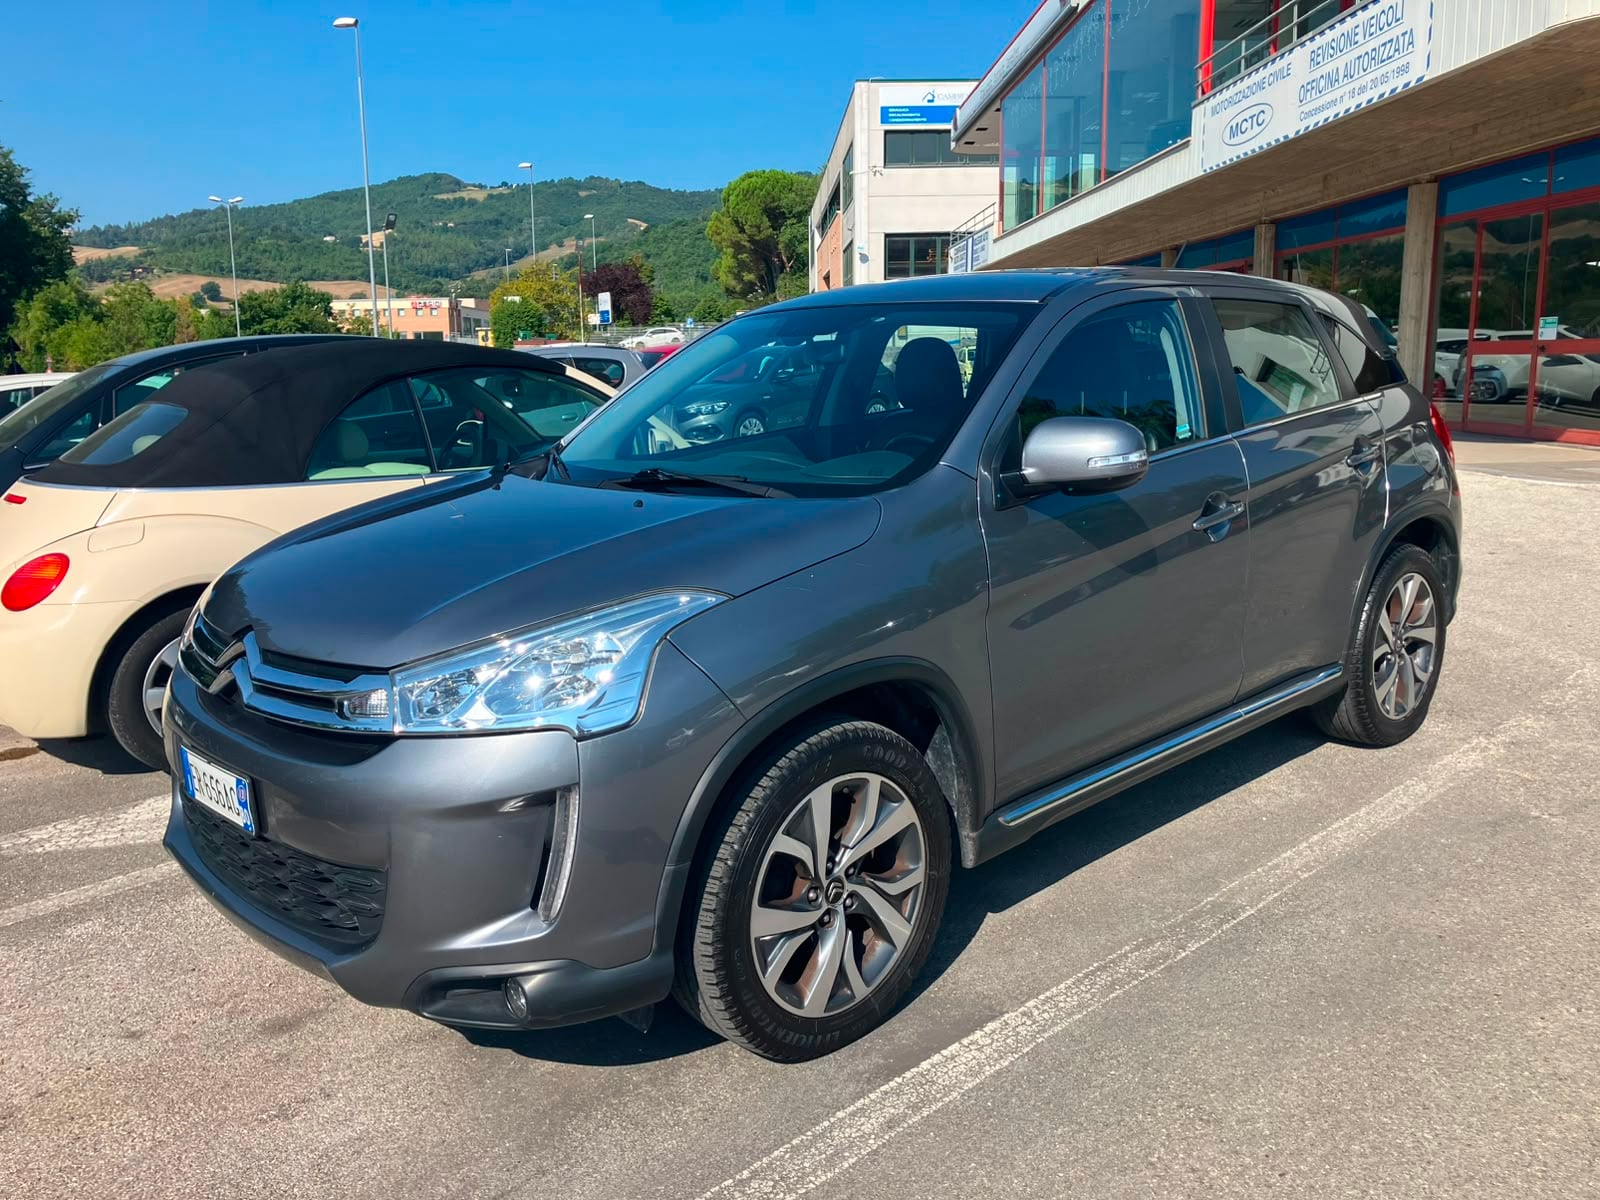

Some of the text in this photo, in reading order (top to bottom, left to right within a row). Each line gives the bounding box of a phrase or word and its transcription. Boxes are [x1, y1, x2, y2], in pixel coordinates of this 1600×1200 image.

[1298, 27, 1415, 104] OFFICINA AUTORIZZATA
[1309, 0, 1405, 70] REVISIONE VEICOLI
[1211, 62, 1292, 117] MOTORIZZAZIONE CIVILE
[1300, 97, 1338, 122] Concessione
[1348, 87, 1356, 99] 18
[1357, 81, 1368, 96] del
[1369, 61, 1410, 90] 20/05/1998
[1229, 109, 1266, 141] MCTC
